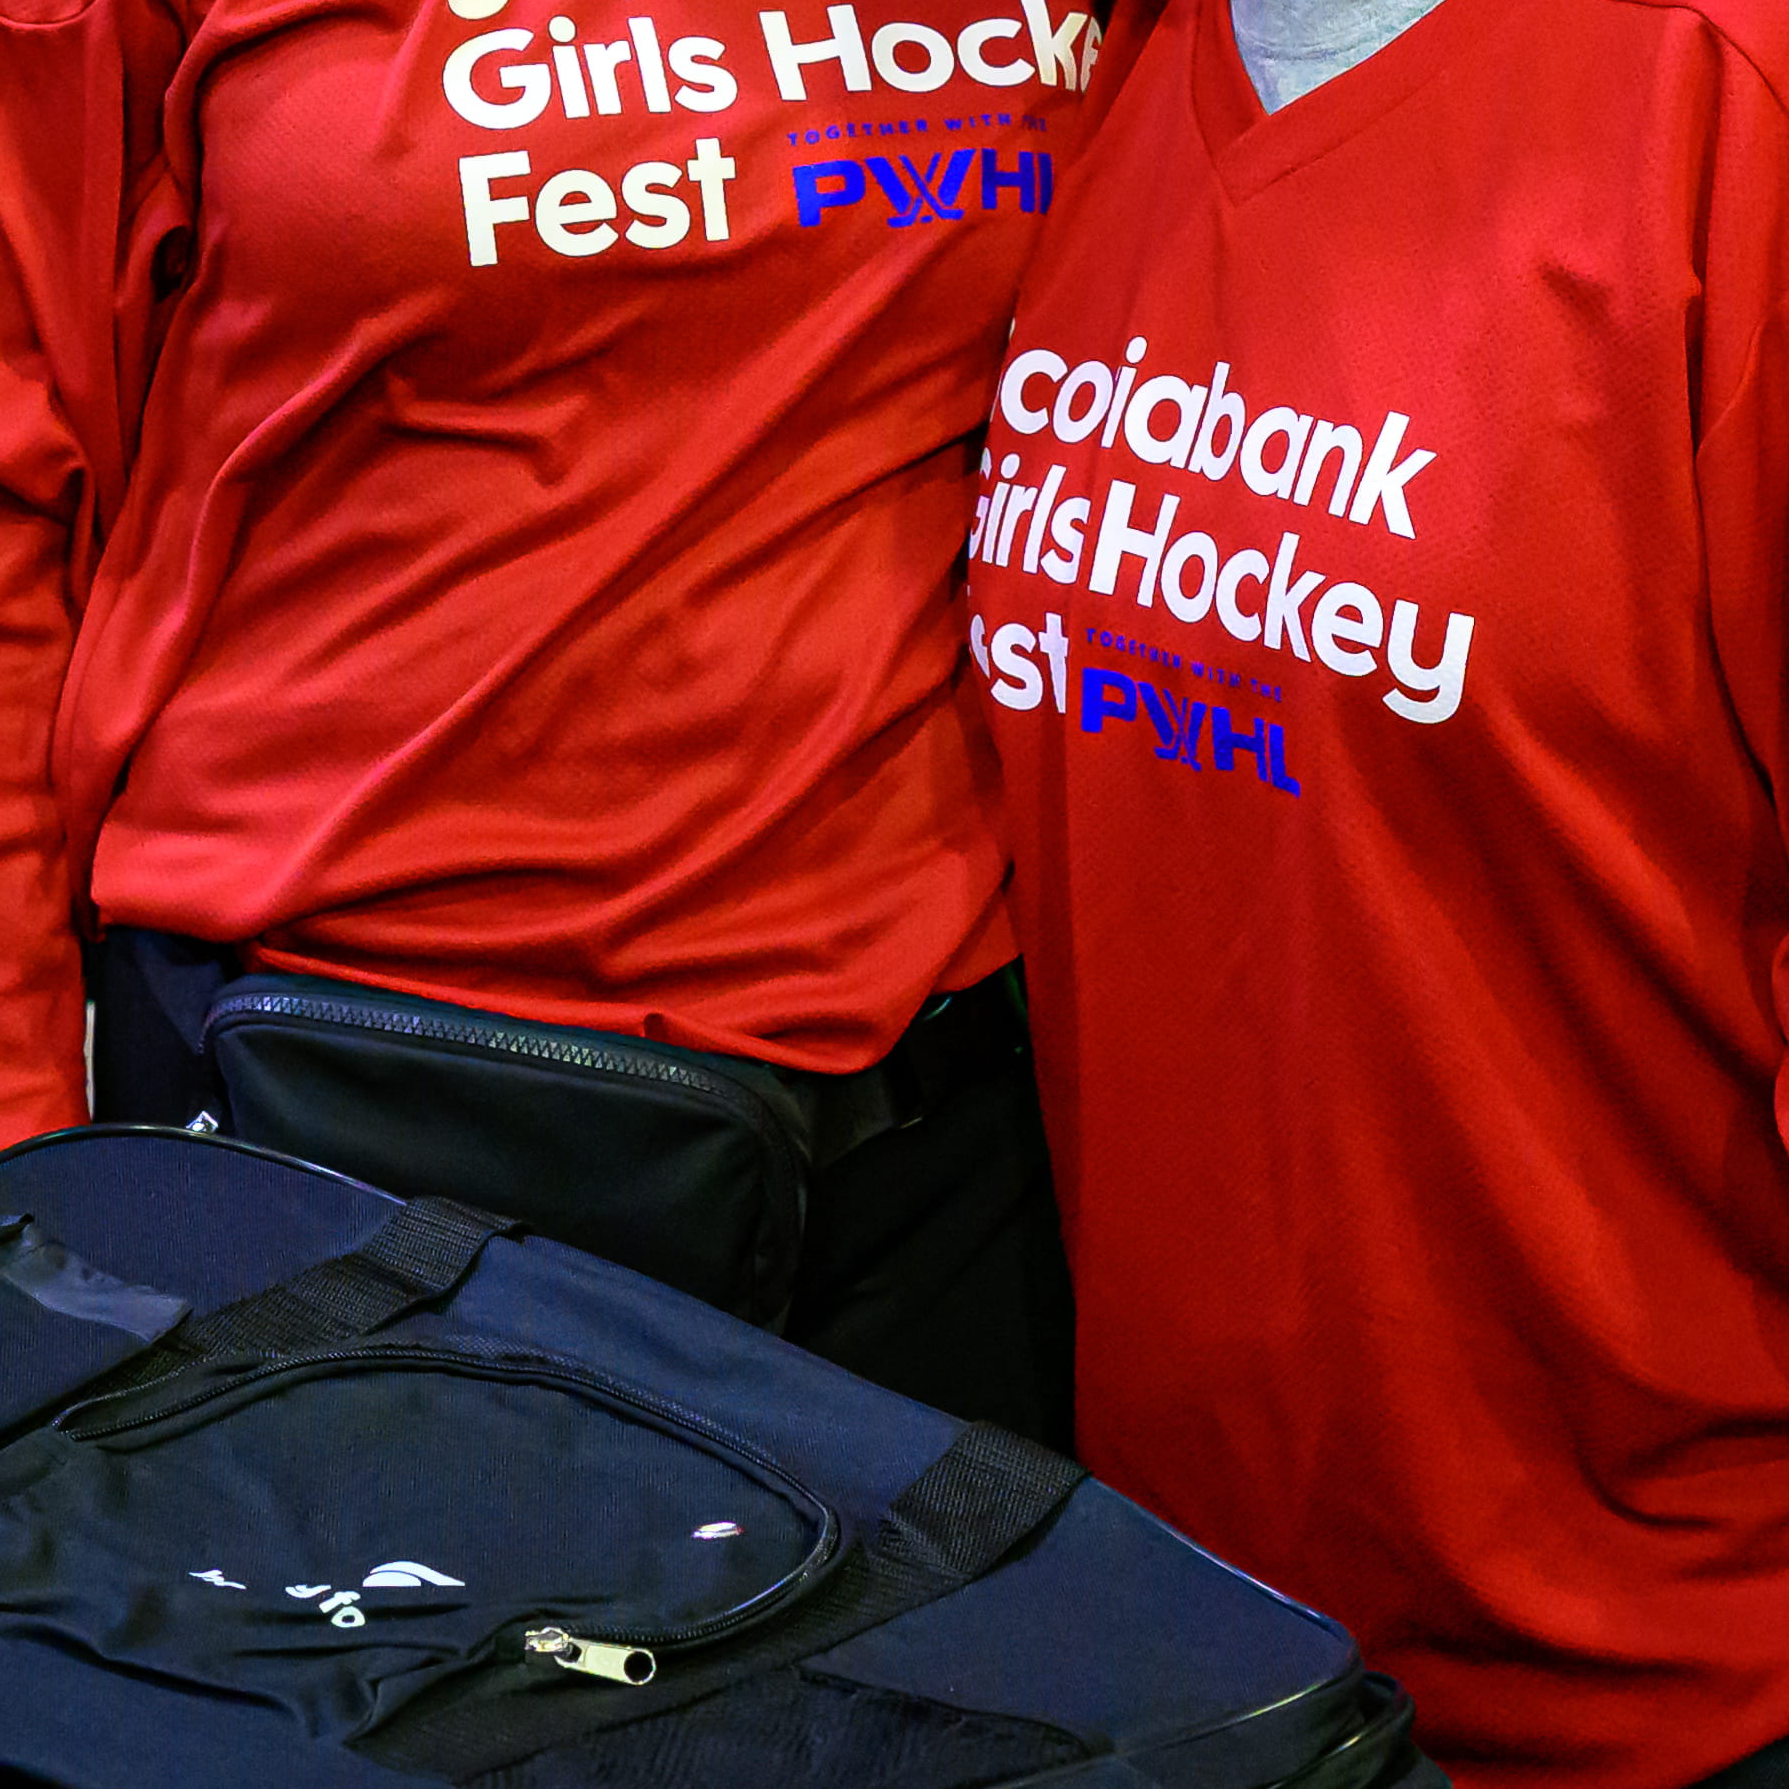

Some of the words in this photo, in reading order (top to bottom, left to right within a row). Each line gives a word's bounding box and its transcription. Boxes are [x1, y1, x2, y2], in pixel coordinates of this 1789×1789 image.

[441, 14, 740, 132] Girls
[786, 117, 929, 148] TOGETHER
[942, 112, 1011, 131] WITH
[457, 136, 737, 268] Fest
[1087, 478, 1476, 725] Hockey
[1085, 626, 1183, 670] TOGETHER
[1190, 660, 1242, 688] WITH
[1250, 677, 1283, 703] THE
[1079, 666, 1302, 799] PWHL
